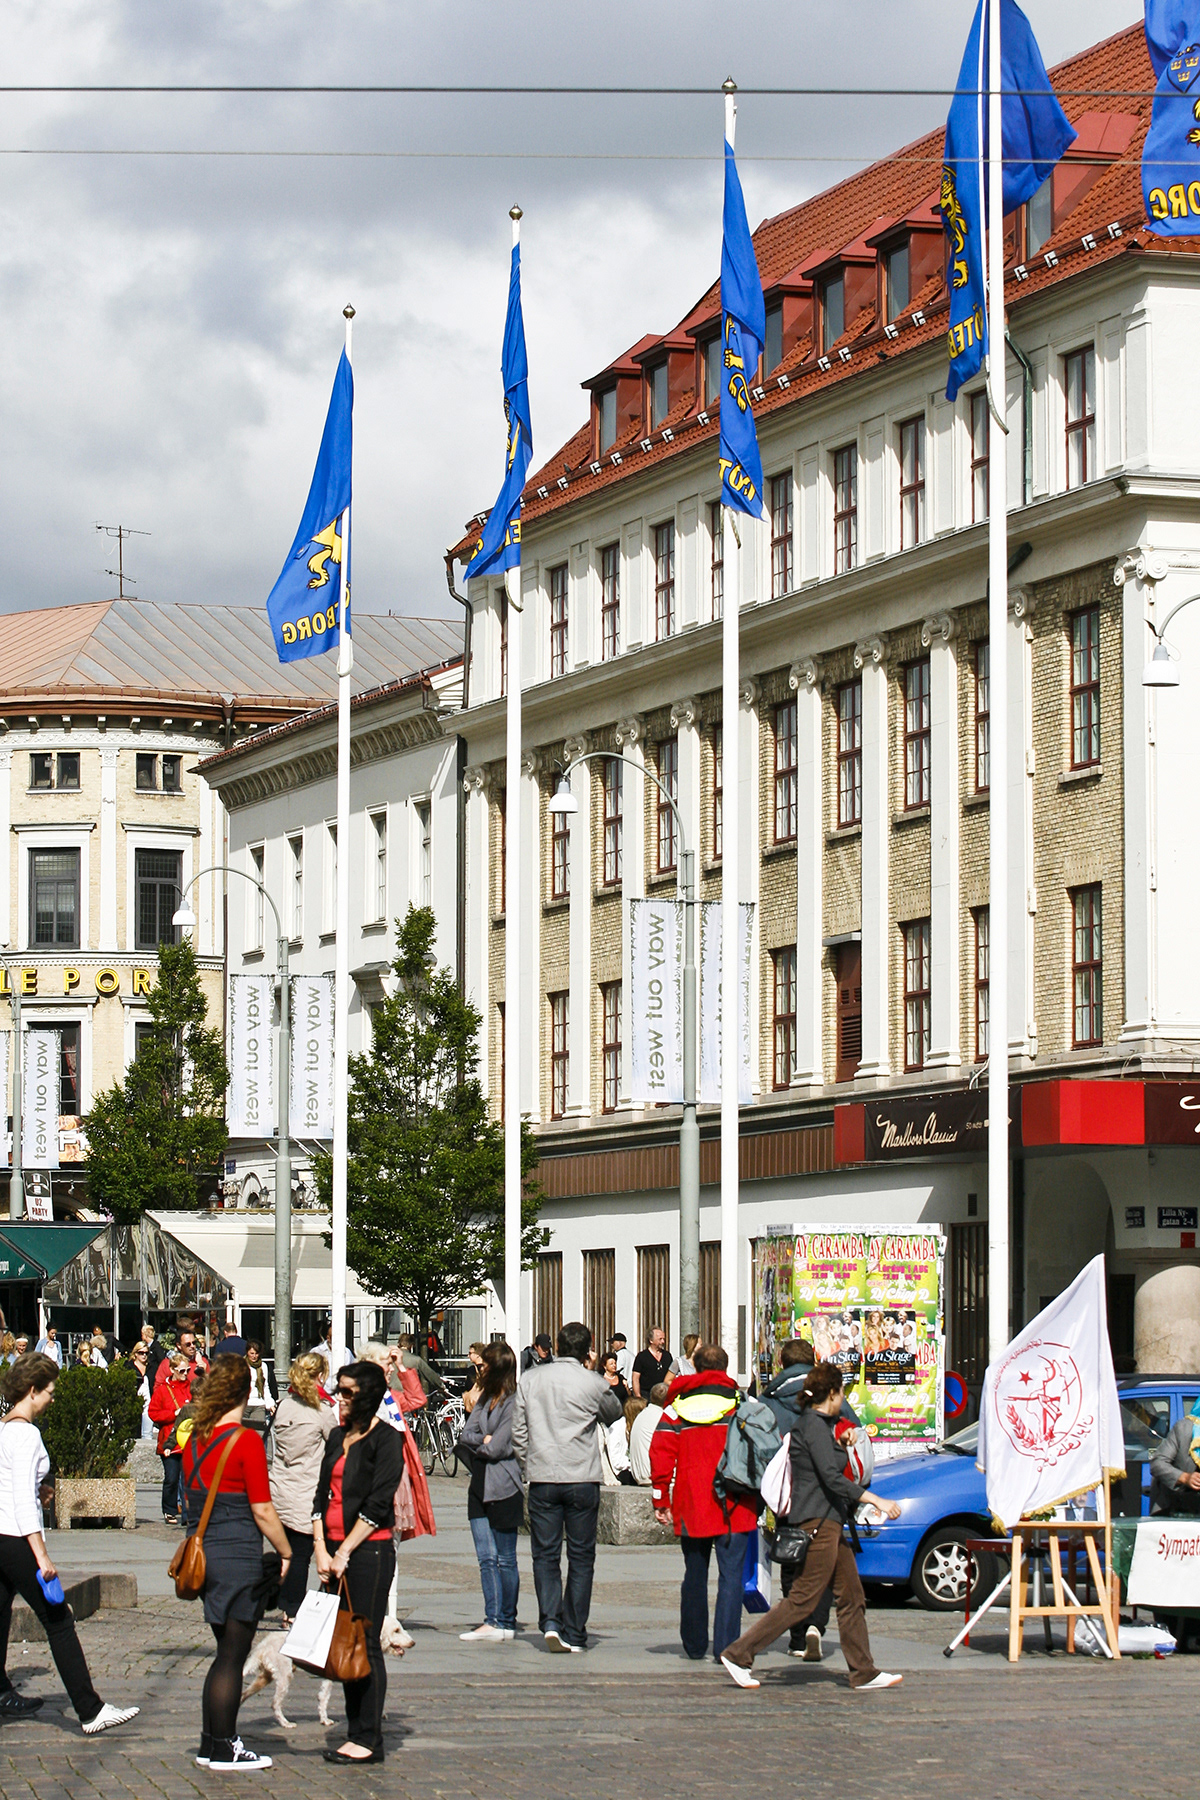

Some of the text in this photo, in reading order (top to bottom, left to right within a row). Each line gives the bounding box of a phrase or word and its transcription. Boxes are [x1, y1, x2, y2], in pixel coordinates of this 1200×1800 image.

[64, 968, 151, 996] POR
[876, 1111, 958, 1148] Marlboro Classics
[32, 1207, 48, 1217] PARTY
[795, 1235, 810, 1259] AY
[812, 1234, 865, 1260] CARAMBA
[869, 1236, 936, 1261] AY CARAMBA
[842, 1263, 857, 1271] AUG
[913, 1265, 929, 1273] AUG
[837, 1351, 860, 1363] Stag
[866, 1352, 883, 1363] On
[883, 1350, 911, 1365] Stage
[1157, 1533, 1200, 1561] Sympat
